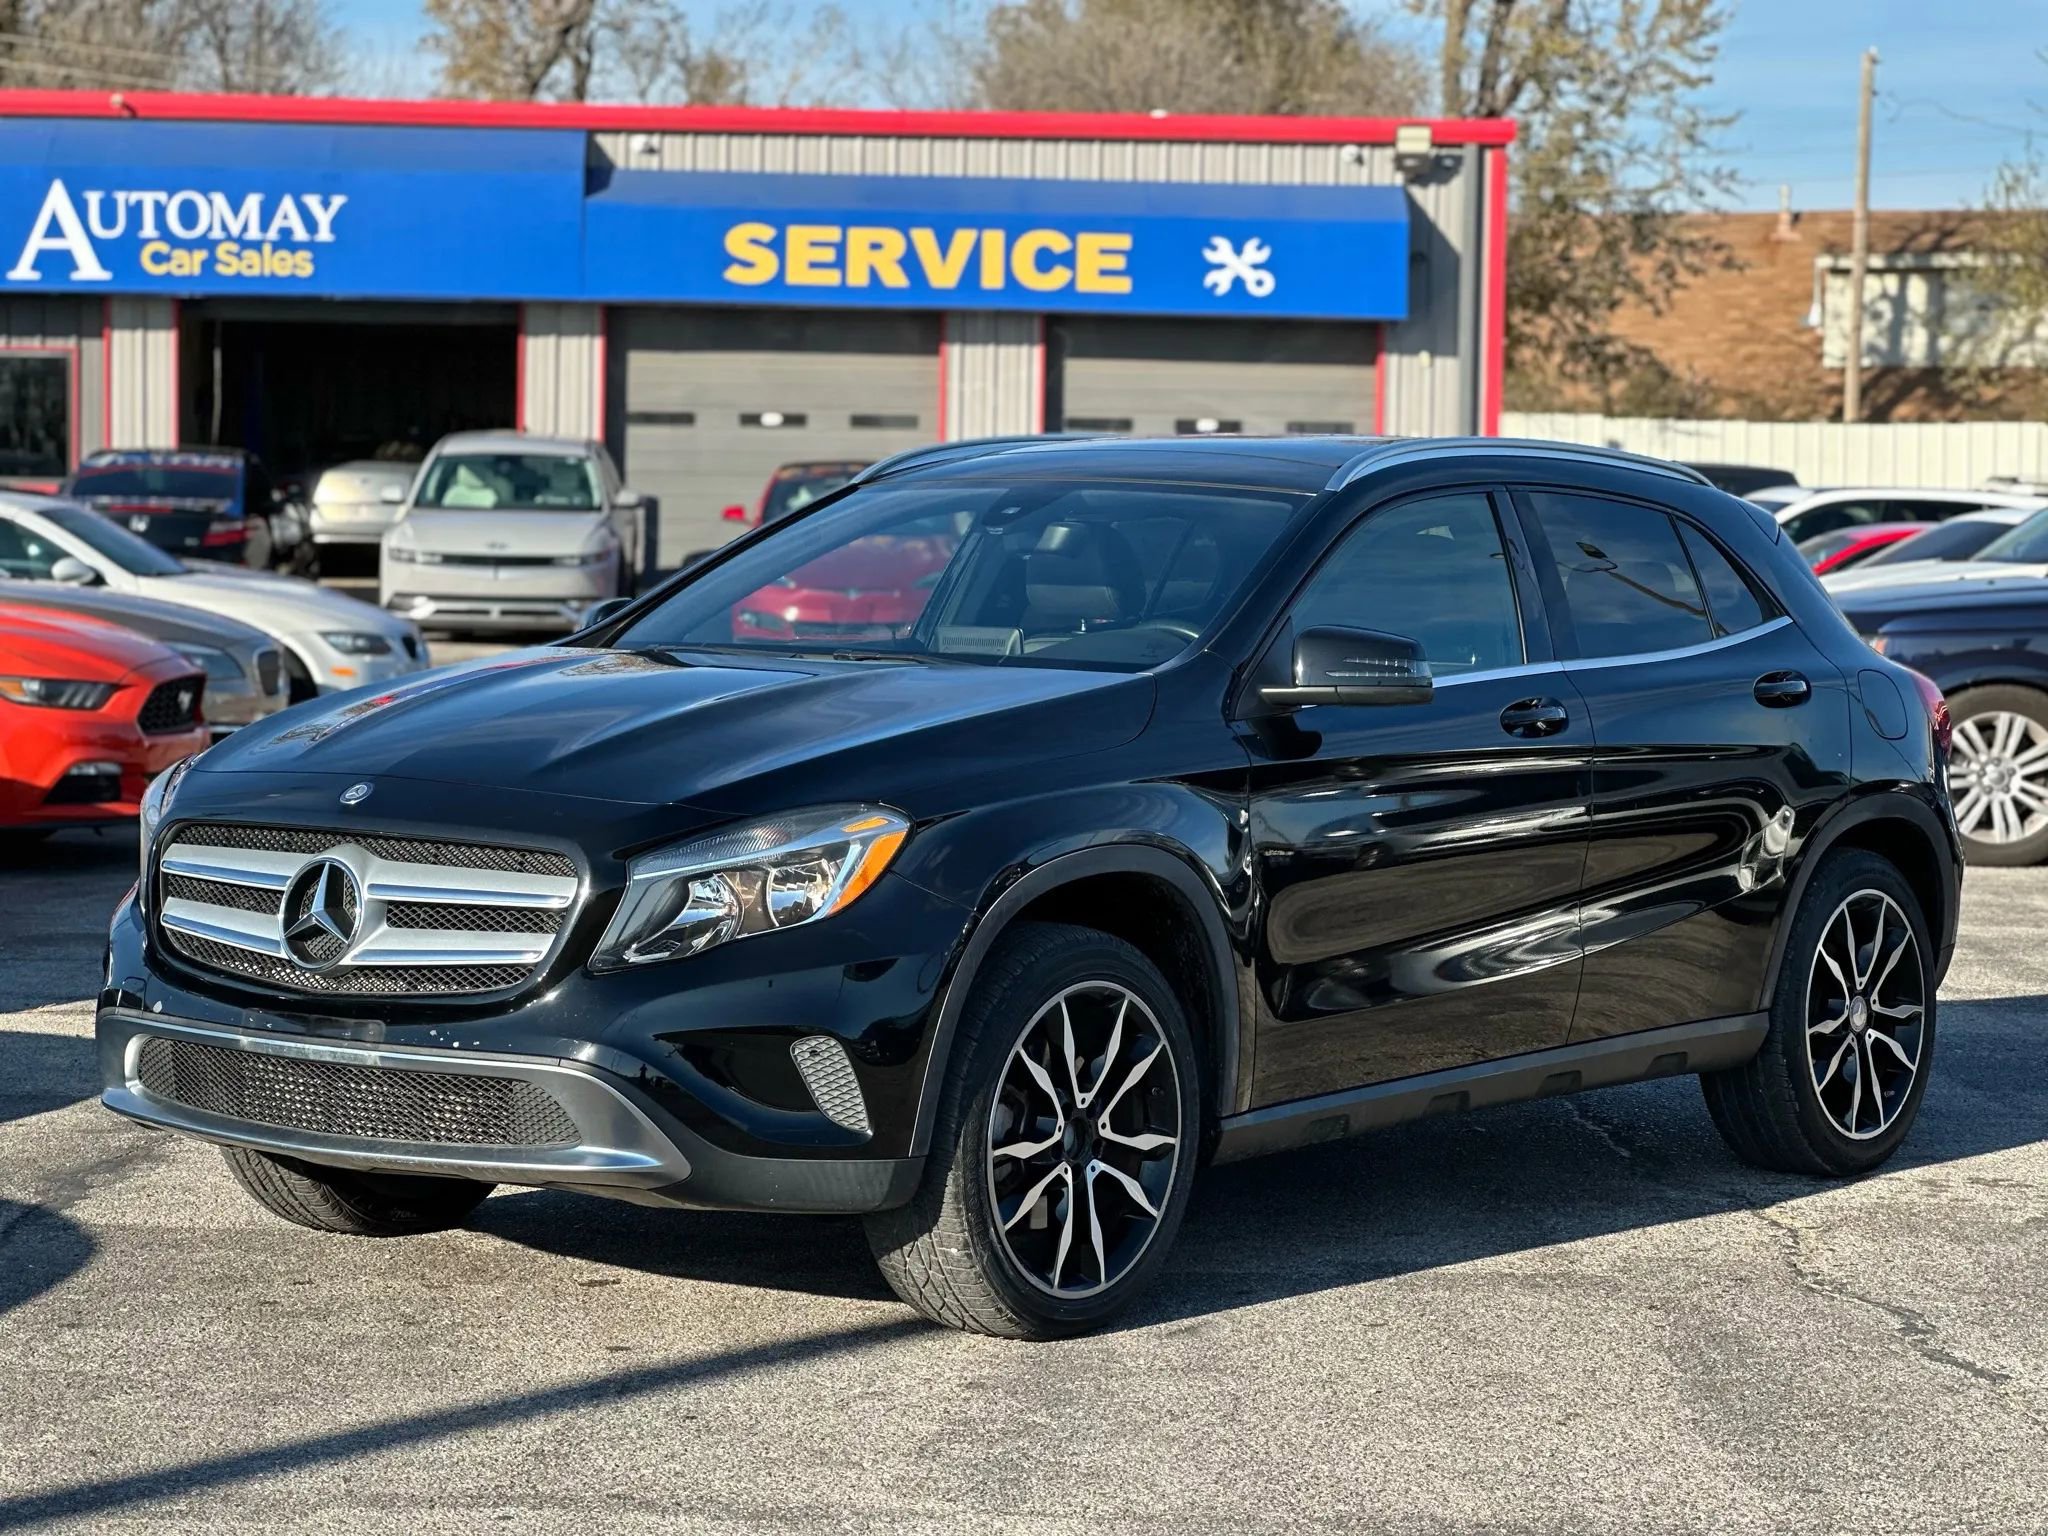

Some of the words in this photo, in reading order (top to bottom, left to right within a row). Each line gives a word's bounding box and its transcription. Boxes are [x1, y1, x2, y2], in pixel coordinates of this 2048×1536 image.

[6, 178, 348, 281] AUTOMAY
[140, 241, 209, 277] Car
[215, 241, 314, 279] Sales
[723, 221, 1133, 294] SERVICE
